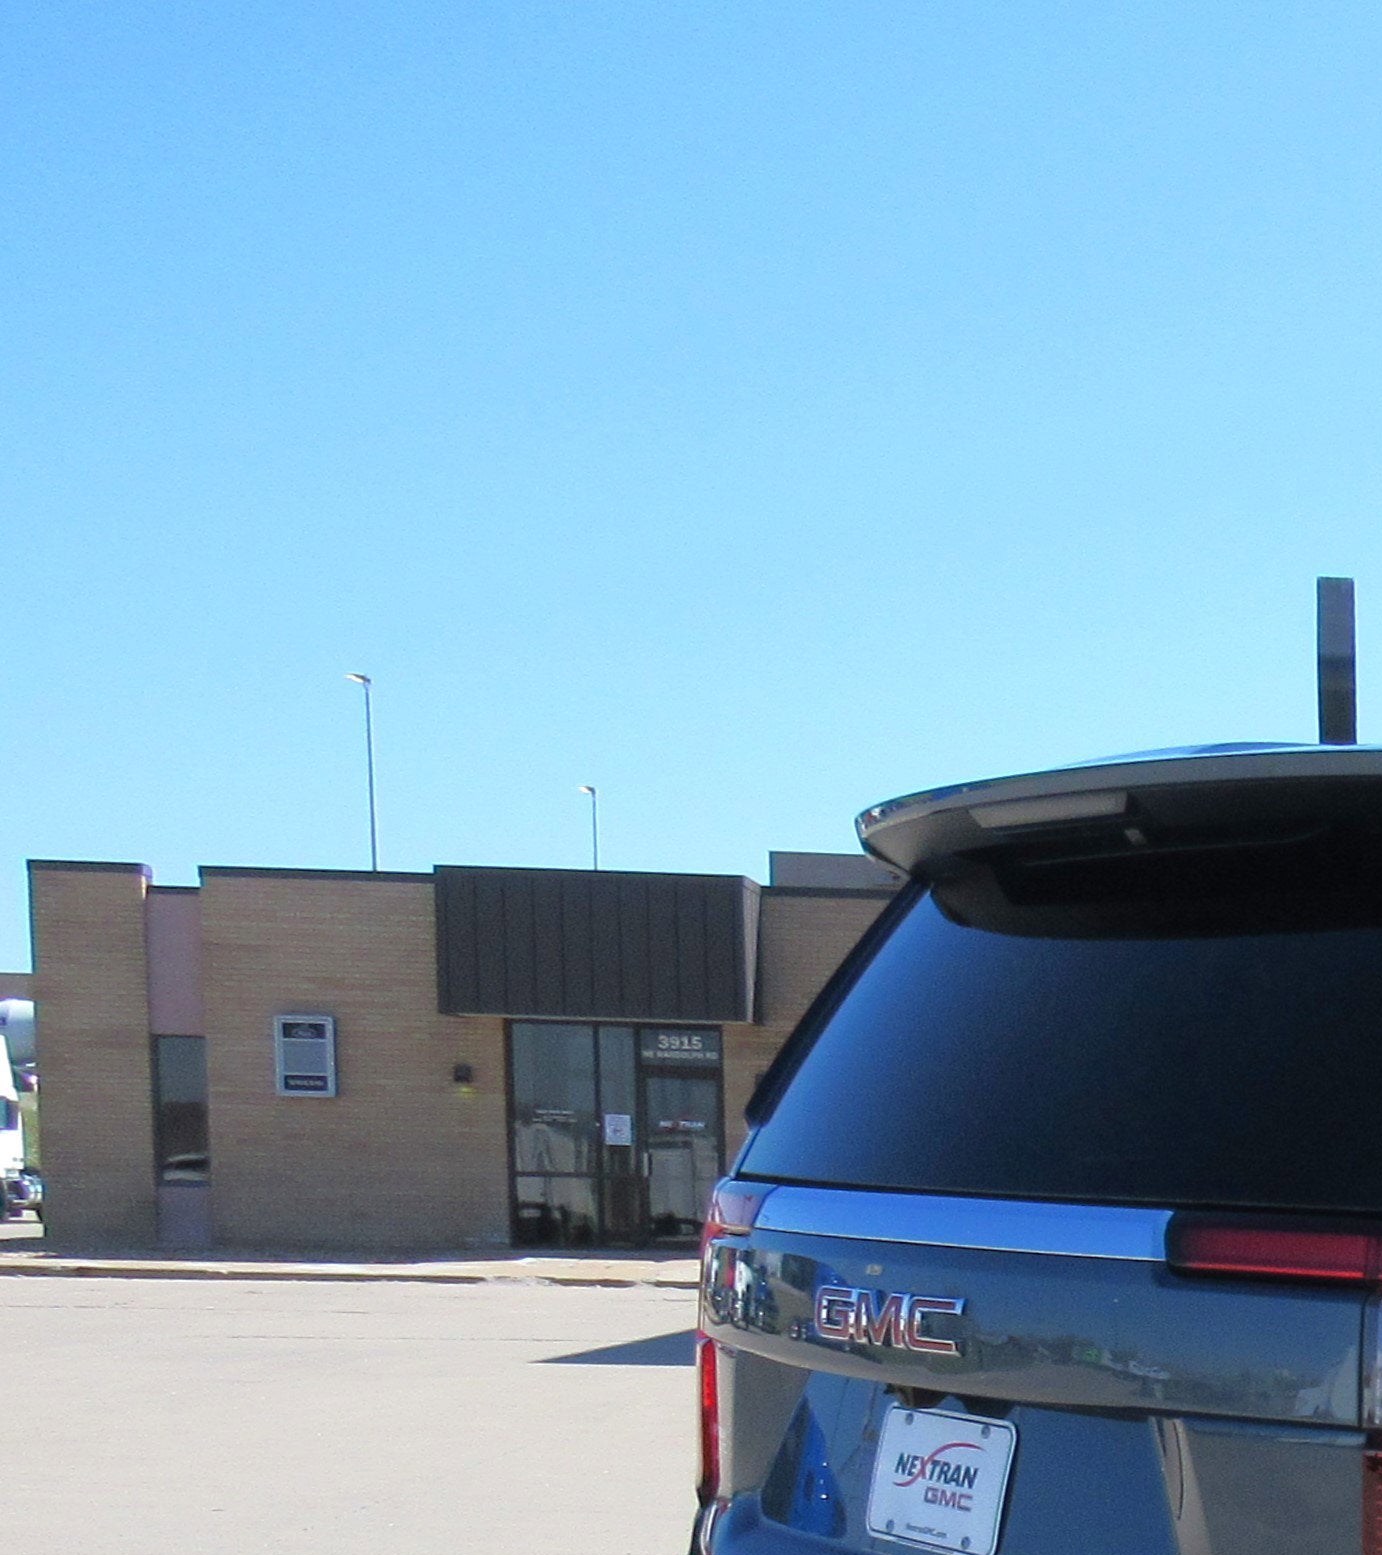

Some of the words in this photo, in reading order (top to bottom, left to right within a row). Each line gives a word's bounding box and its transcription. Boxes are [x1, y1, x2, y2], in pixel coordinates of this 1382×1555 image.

[658, 1035, 703, 1050] 3915
[814, 1284, 966, 1357] GMC
[894, 1452, 980, 1490] NEXTRAN
[924, 1485, 974, 1513] GMC
